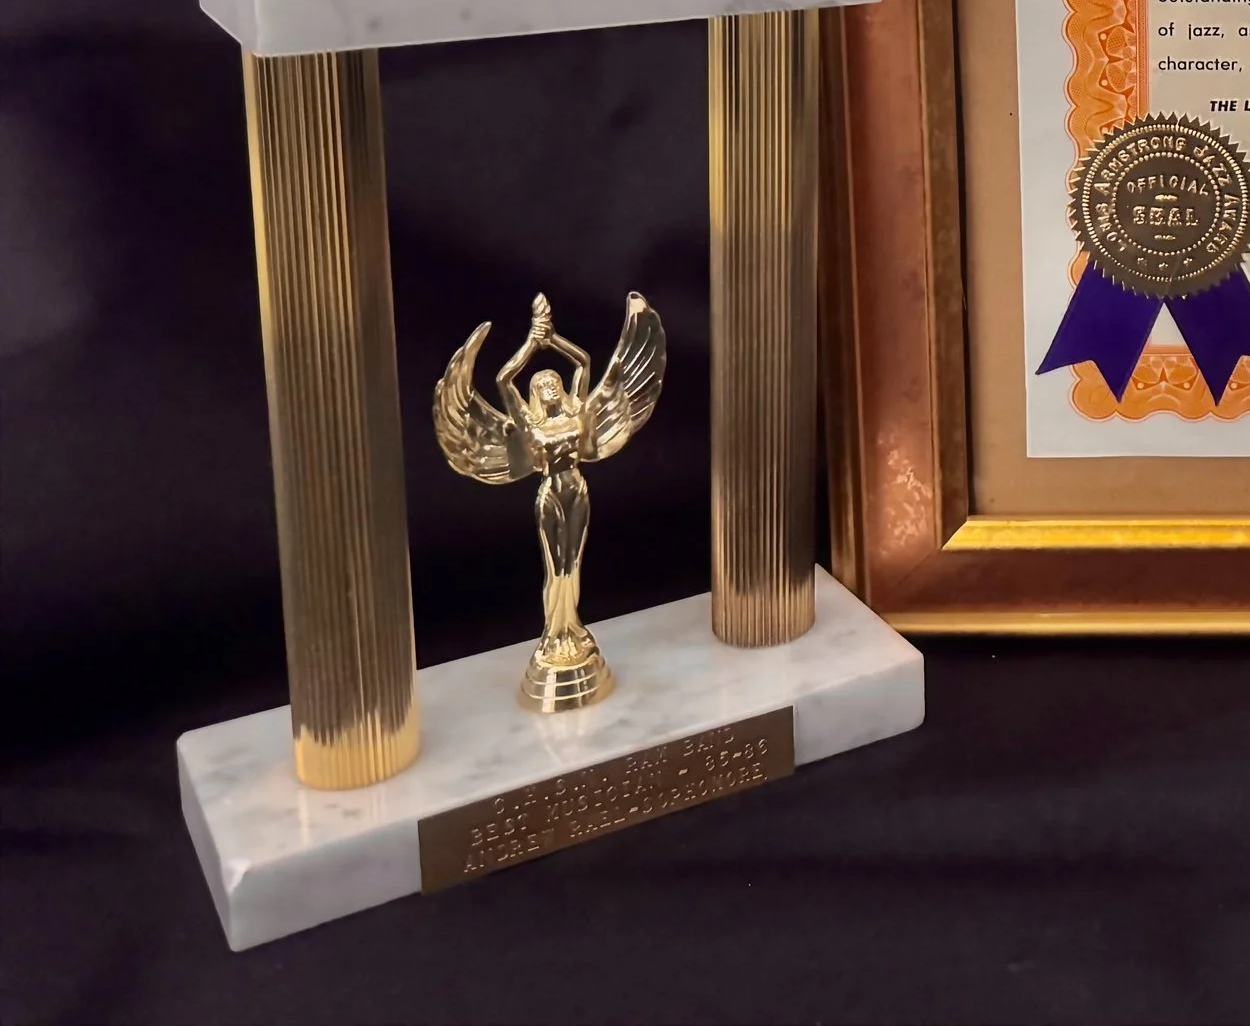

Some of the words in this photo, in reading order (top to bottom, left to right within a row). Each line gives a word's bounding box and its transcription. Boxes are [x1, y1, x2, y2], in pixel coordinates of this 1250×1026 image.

[1157, 21, 1175, 37] of
[1188, 23, 1225, 41] jazz,
[1158, 55, 1242, 73] character,
[1209, 100, 1238, 112] THE
[1094, 135, 1187, 196] ARMSTRONG
[1126, 175, 1210, 196] OFFICIAL
[1133, 205, 1199, 226] SEAL
[470, 812, 528, 847] BEST
